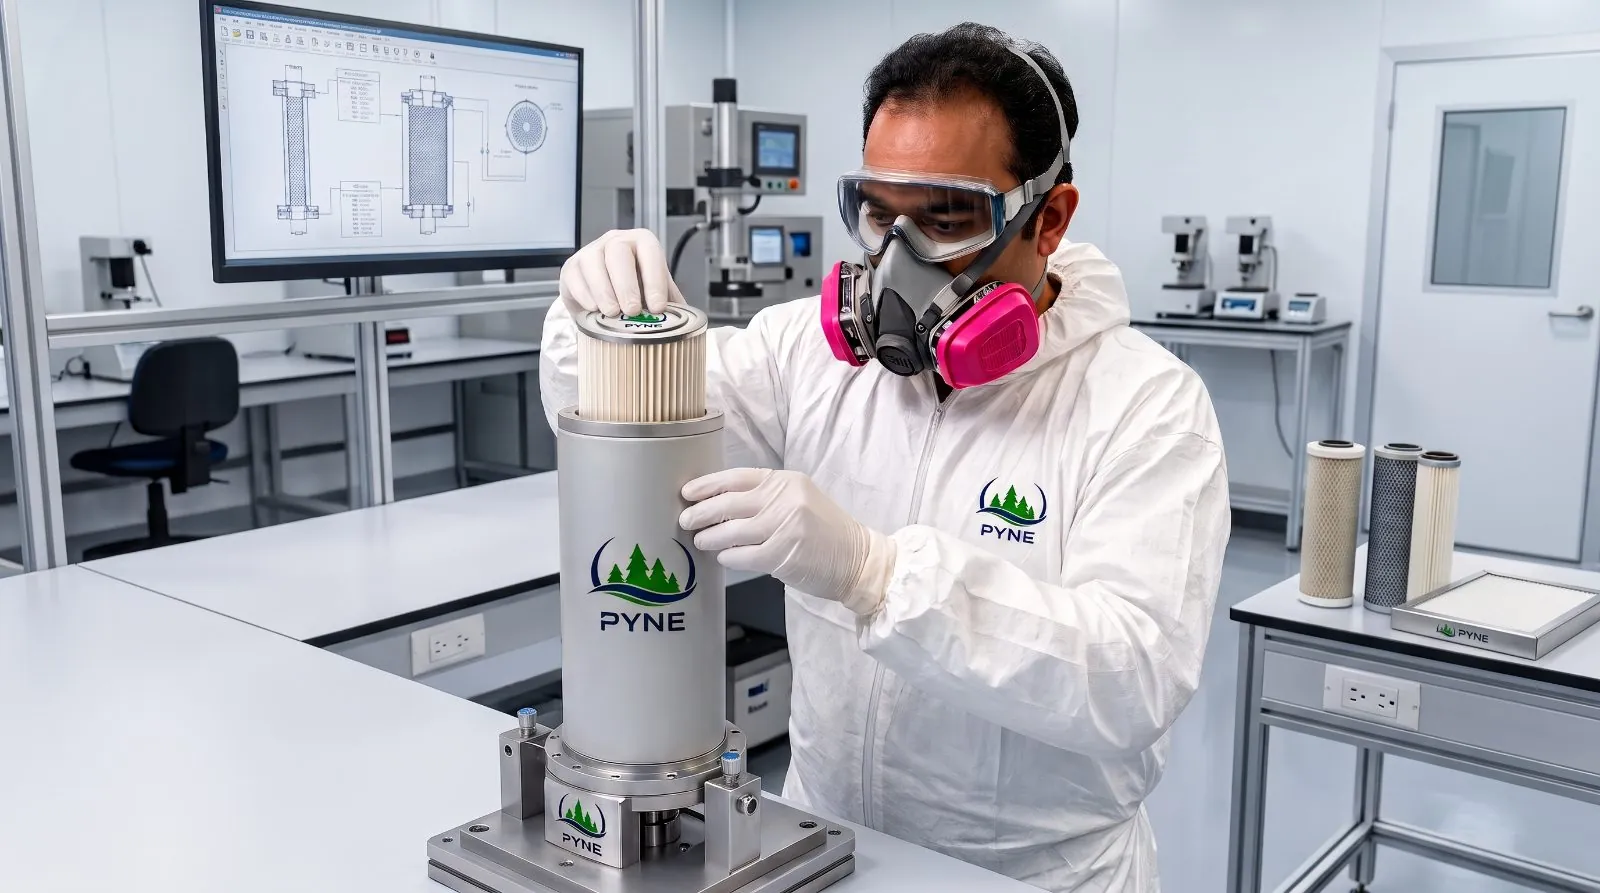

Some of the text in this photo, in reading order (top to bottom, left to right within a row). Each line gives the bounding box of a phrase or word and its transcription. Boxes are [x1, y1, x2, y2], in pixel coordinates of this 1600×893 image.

[980, 523, 1035, 544] PYNE
[600, 611, 686, 632] PYNE
[1458, 629, 1489, 643] PYNE
[562, 833, 602, 856] PYNE
